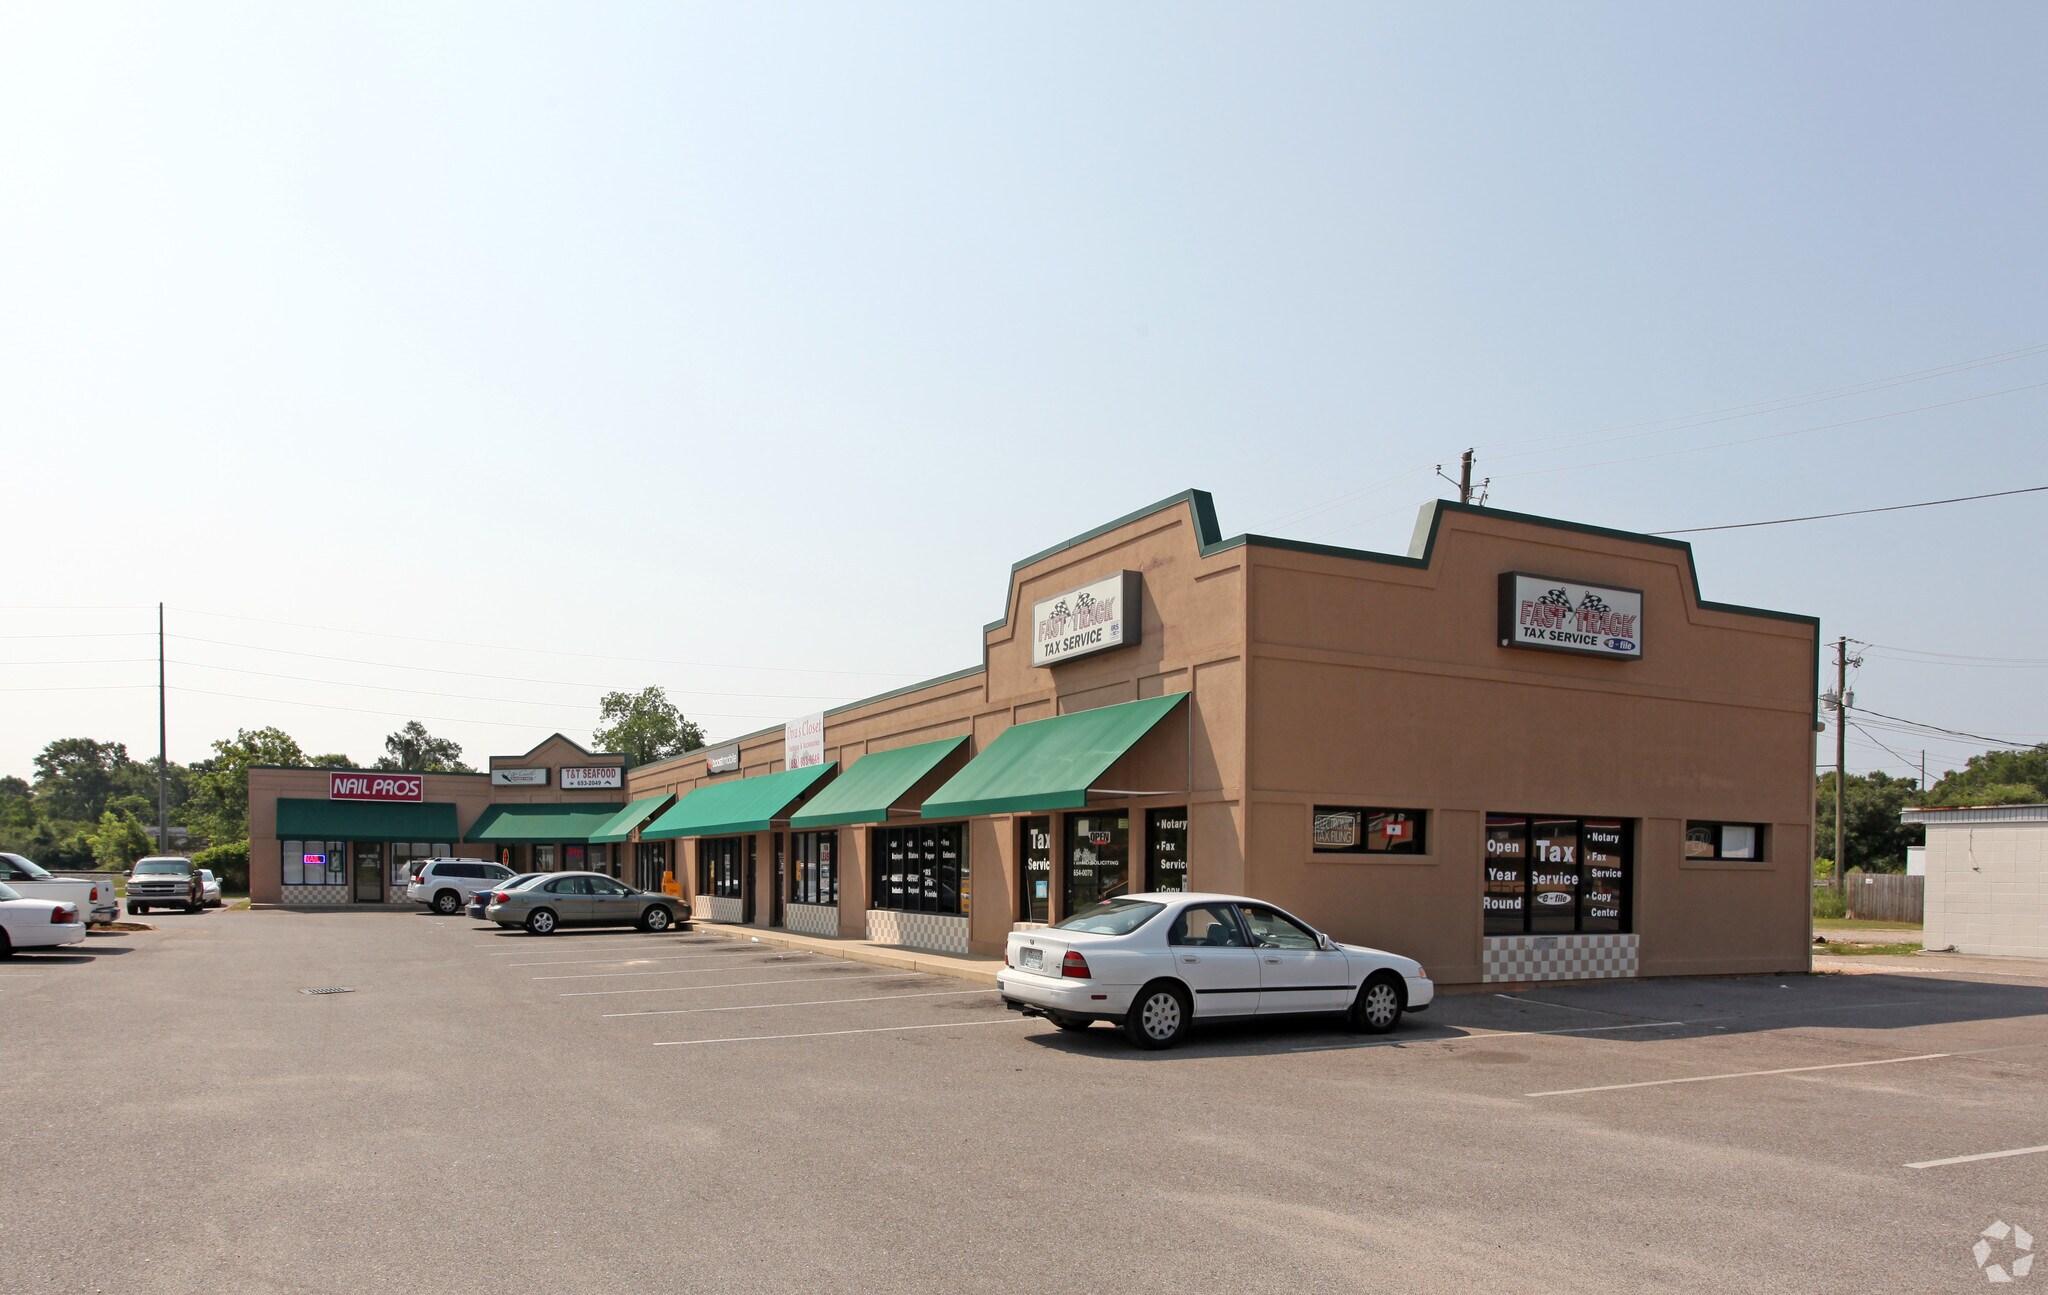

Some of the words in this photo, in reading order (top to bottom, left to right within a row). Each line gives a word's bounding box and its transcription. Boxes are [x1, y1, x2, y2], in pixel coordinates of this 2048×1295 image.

[1038, 615, 1067, 642] FAST
[1072, 596, 1115, 631] TRACK
[1520, 600, 1567, 629] FAST
[1575, 607, 1637, 638] TRACK
[1044, 640, 1061, 657] TAX
[1063, 628, 1103, 651] SERVICE
[1523, 627, 1545, 639] TAX
[1549, 631, 1598, 646] SERVICE
[802, 718, 821, 736] Closet
[566, 768, 580, 779] T&T
[583, 768, 616, 779] SEAFOOD
[333, 778, 370, 795] NAIL
[372, 779, 420, 796] PROS
[1161, 819, 1188, 830] Notary
[1317, 817, 1353, 831] ELECTRONIC
[1030, 829, 1050, 849] Tax
[1090, 832, 1110, 843] OPEN
[1317, 831, 1330, 842] TAX
[1331, 831, 1352, 843] FILING
[1592, 832, 1619, 843] Notary
[1161, 841, 1175, 851] Fax
[1487, 839, 1519, 854] Open
[1536, 840, 1574, 862] Tax
[1592, 852, 1607, 861] Fax
[1028, 857, 1050, 870] Servic
[1161, 859, 1188, 869] Servic
[1489, 868, 1517, 881] Year
[1532, 871, 1579, 885] Service
[1591, 868, 1622, 878] Service
[1483, 897, 1521, 909] Round
[1591, 891, 1612, 902] Copy
[1591, 908, 1618, 917] Center
